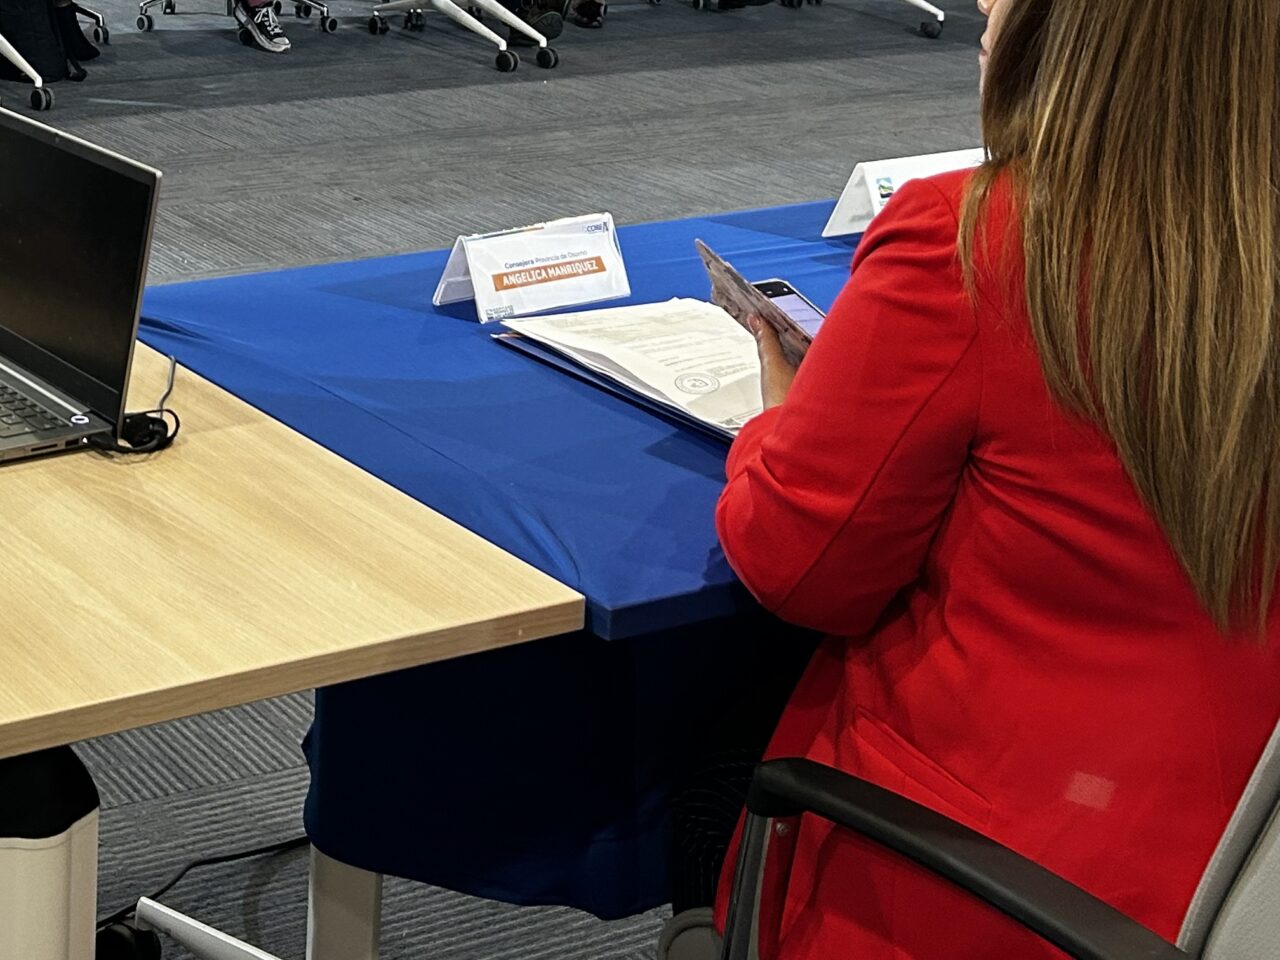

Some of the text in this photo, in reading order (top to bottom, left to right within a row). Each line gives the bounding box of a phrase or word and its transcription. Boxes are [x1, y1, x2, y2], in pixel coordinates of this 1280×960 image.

[504, 259, 534, 269] Consejera
[535, 255, 559, 263] Provincia
[502, 260, 599, 287] ANGELICA MANRIQUEZ
